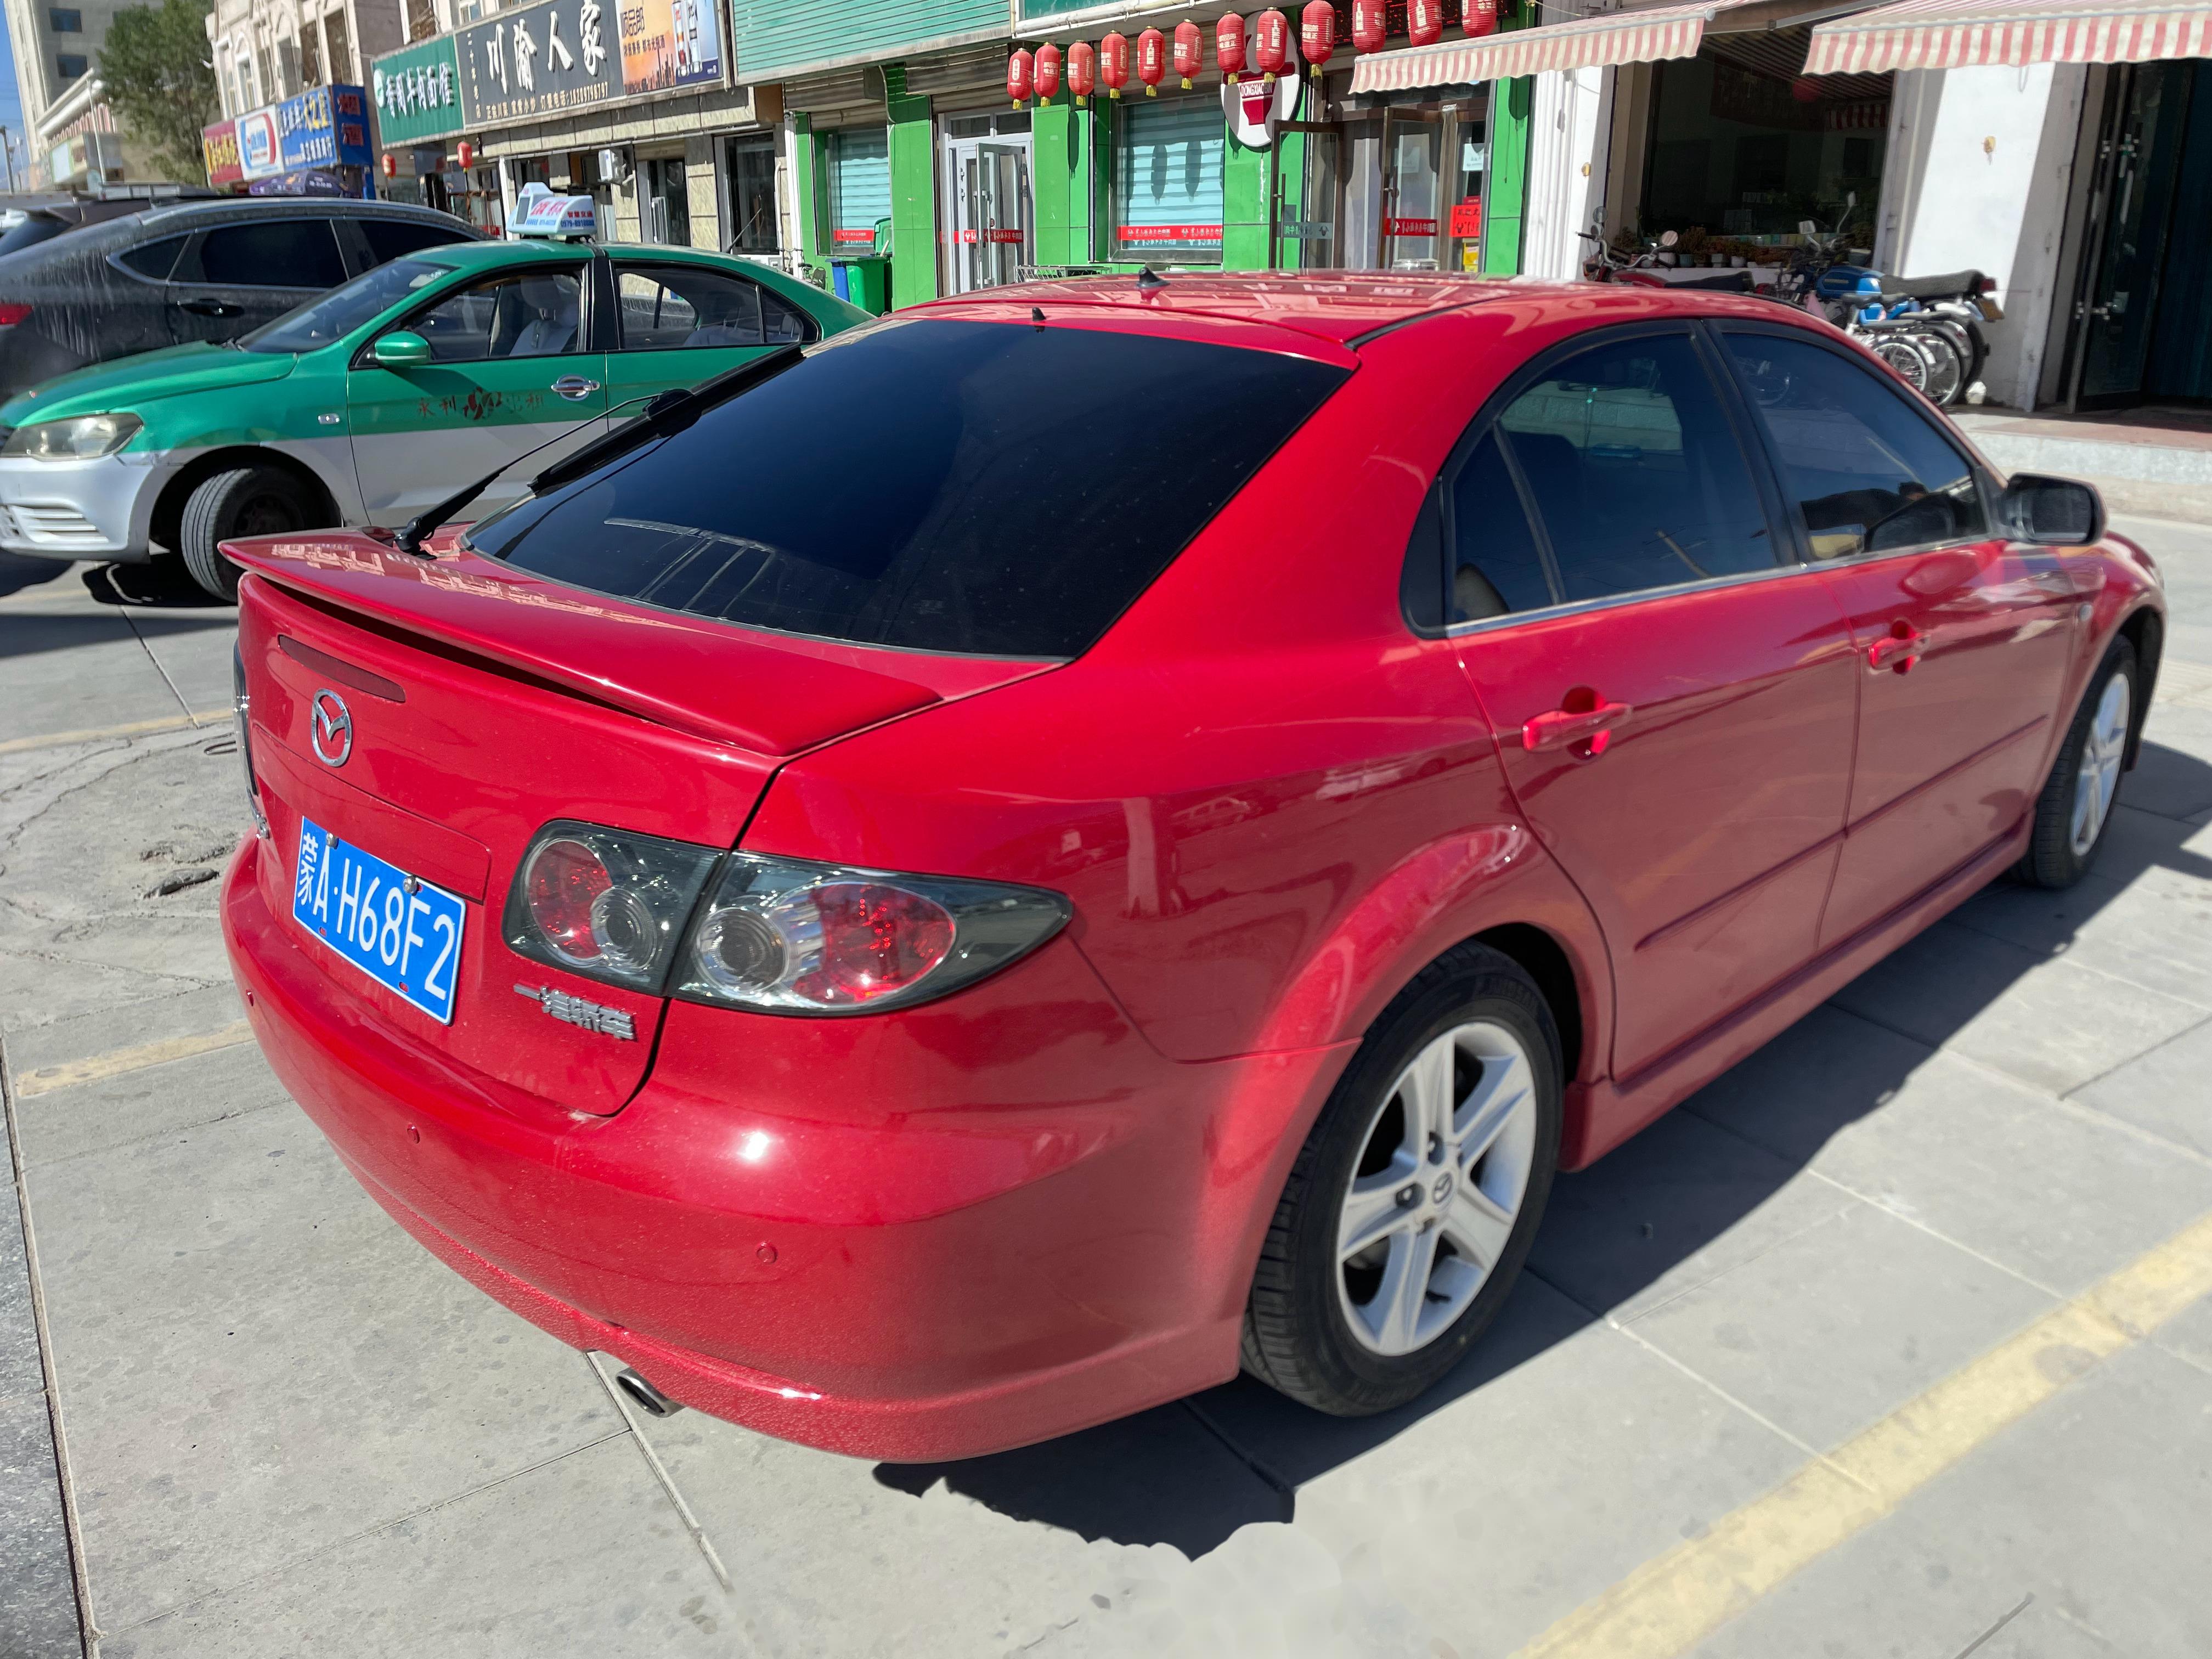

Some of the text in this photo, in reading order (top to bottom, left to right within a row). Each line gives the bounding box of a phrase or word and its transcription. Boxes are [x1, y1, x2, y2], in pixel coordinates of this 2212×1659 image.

[486, 0, 606, 94] 川渝人家
[514, 985, 638, 1040] 一汽轿车
